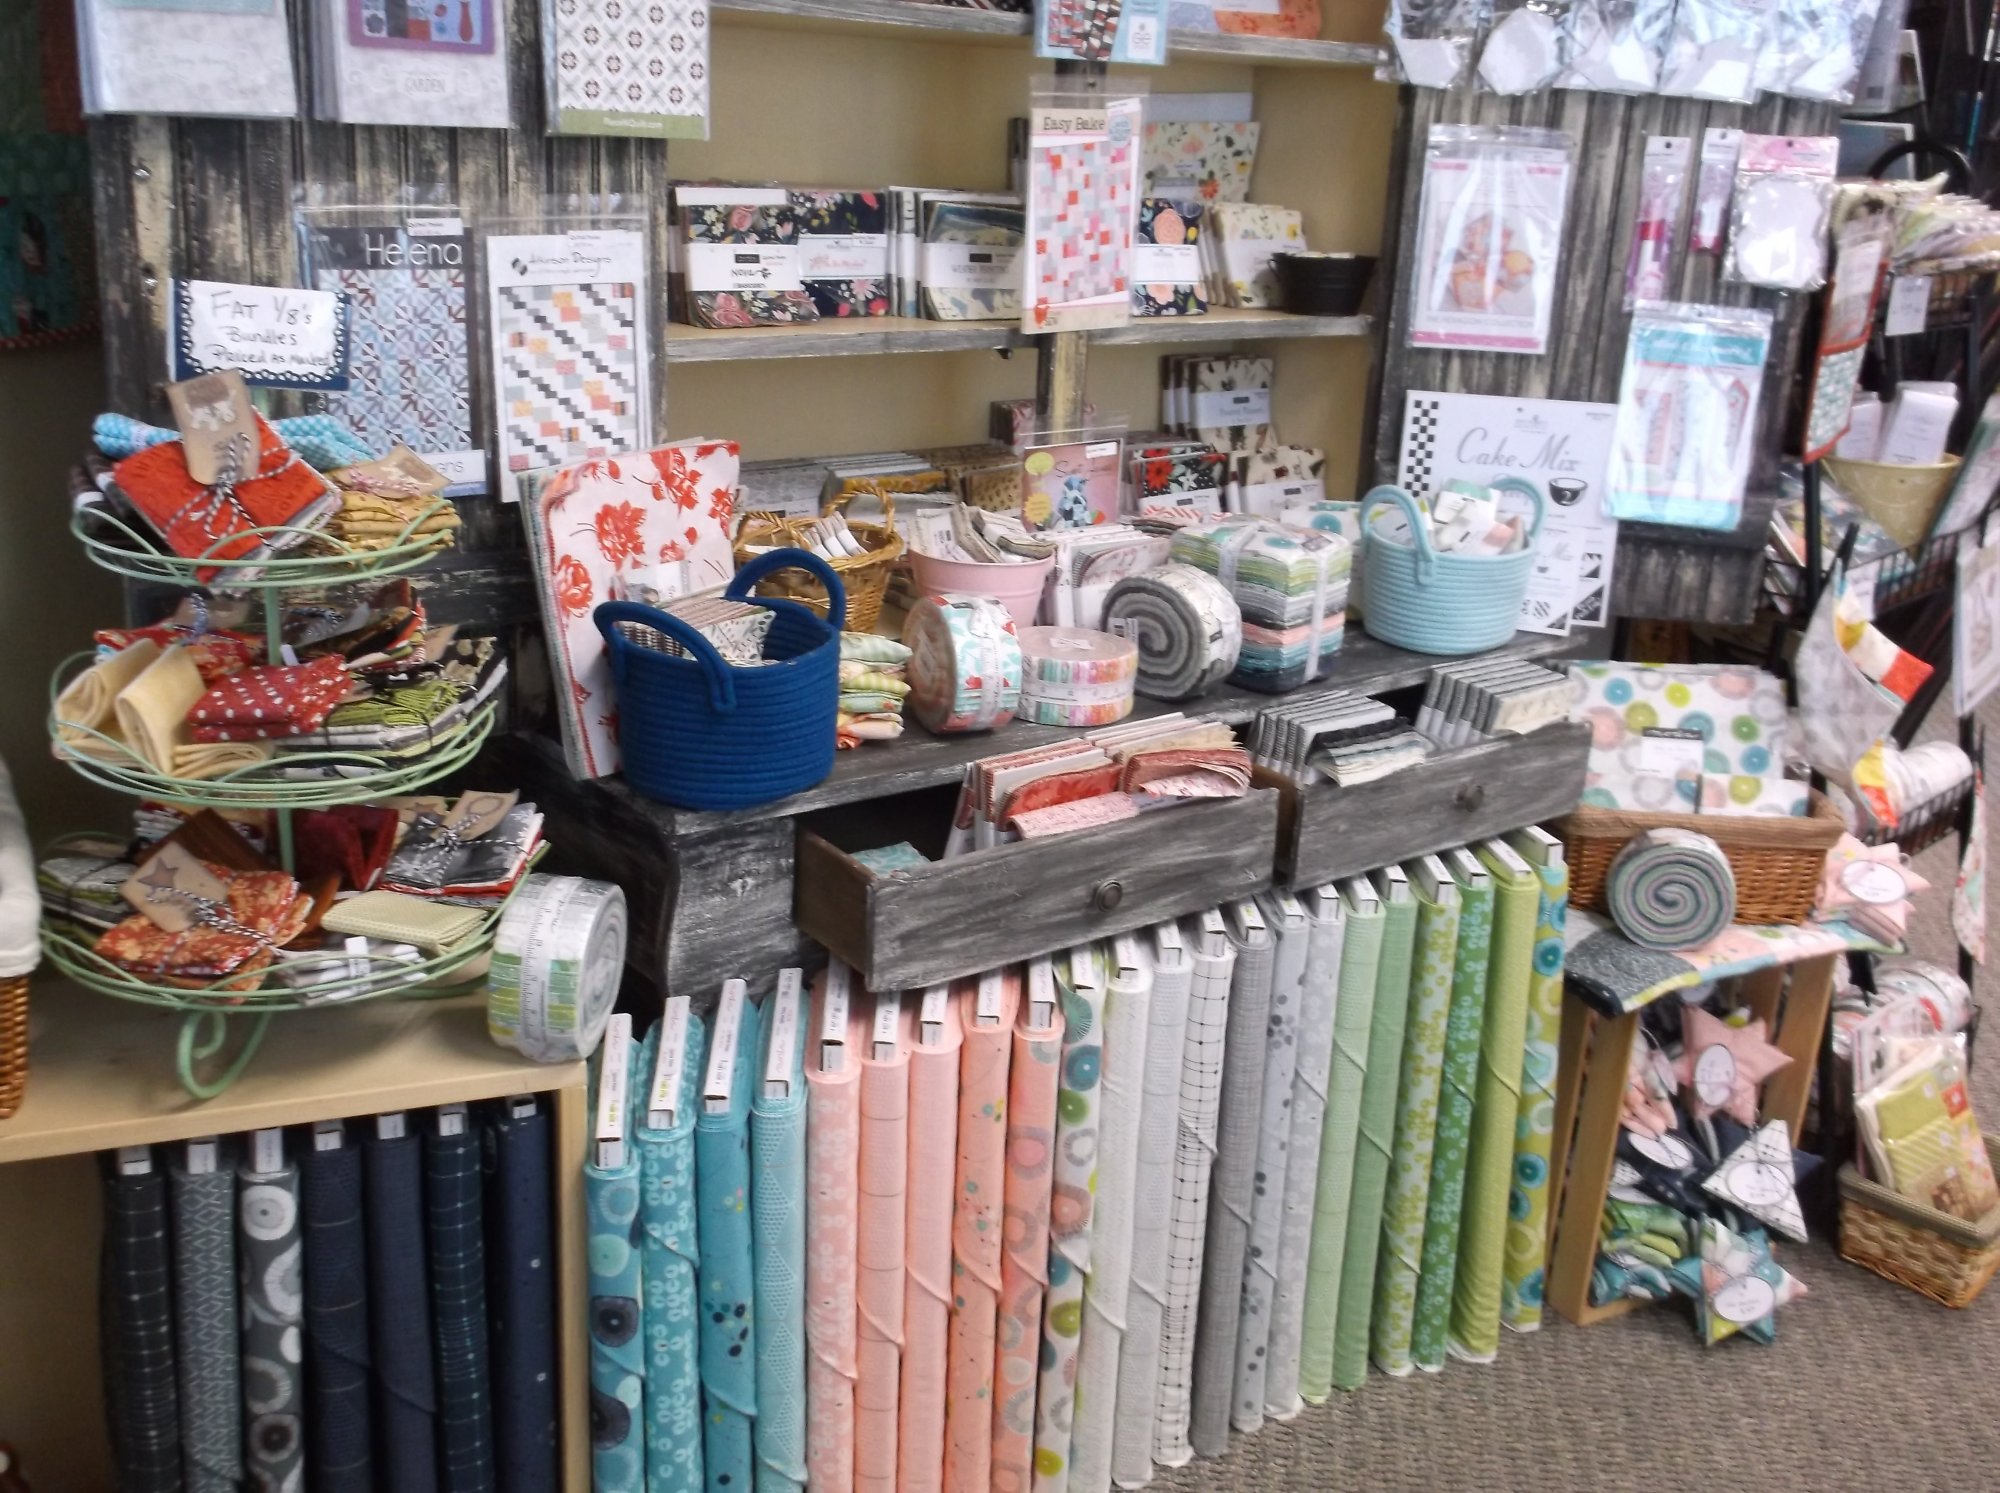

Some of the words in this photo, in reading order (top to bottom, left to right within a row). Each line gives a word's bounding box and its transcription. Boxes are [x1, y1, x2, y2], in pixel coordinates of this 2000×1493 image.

[1043, 116, 1072, 133] Easy
[1075, 117, 1105, 131] Bake
[365, 233, 463, 266] Helena
[217, 325, 299, 347] Bundles
[1456, 426, 1518, 467] Cake
[1519, 433, 1584, 472] Mix
